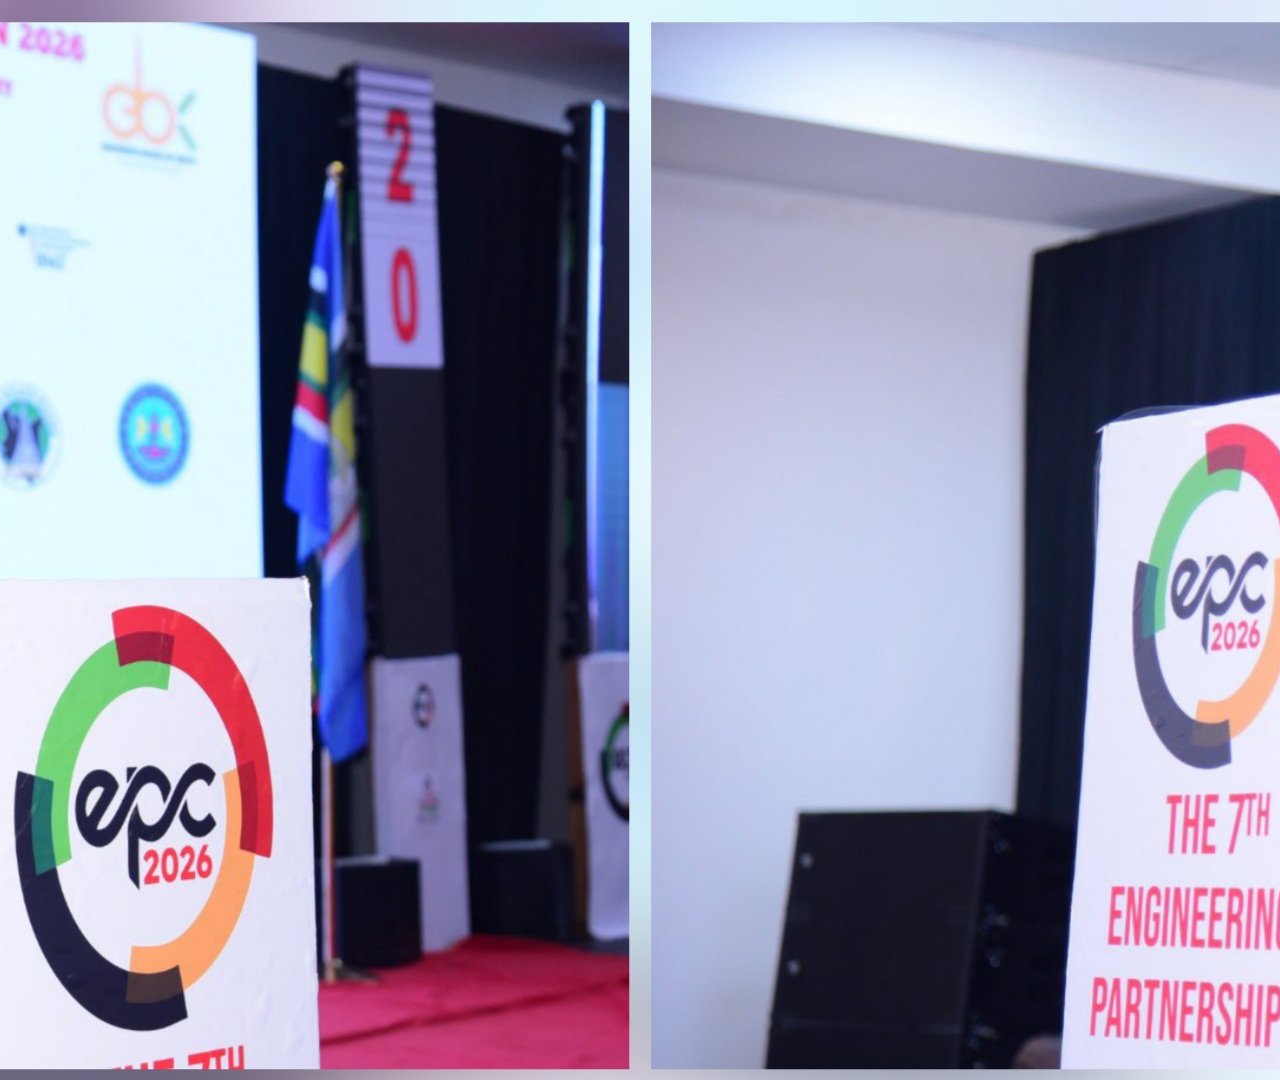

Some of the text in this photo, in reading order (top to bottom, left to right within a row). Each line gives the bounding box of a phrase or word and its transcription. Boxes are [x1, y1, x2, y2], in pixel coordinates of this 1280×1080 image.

[19, 22, 85, 61] 2026
[1170, 550, 1269, 655] epc
[1210, 619, 1261, 652] 2026
[75, 762, 217, 891] epc
[1166, 793, 1272, 855] THE 7TH
[143, 845, 213, 885] 2026
